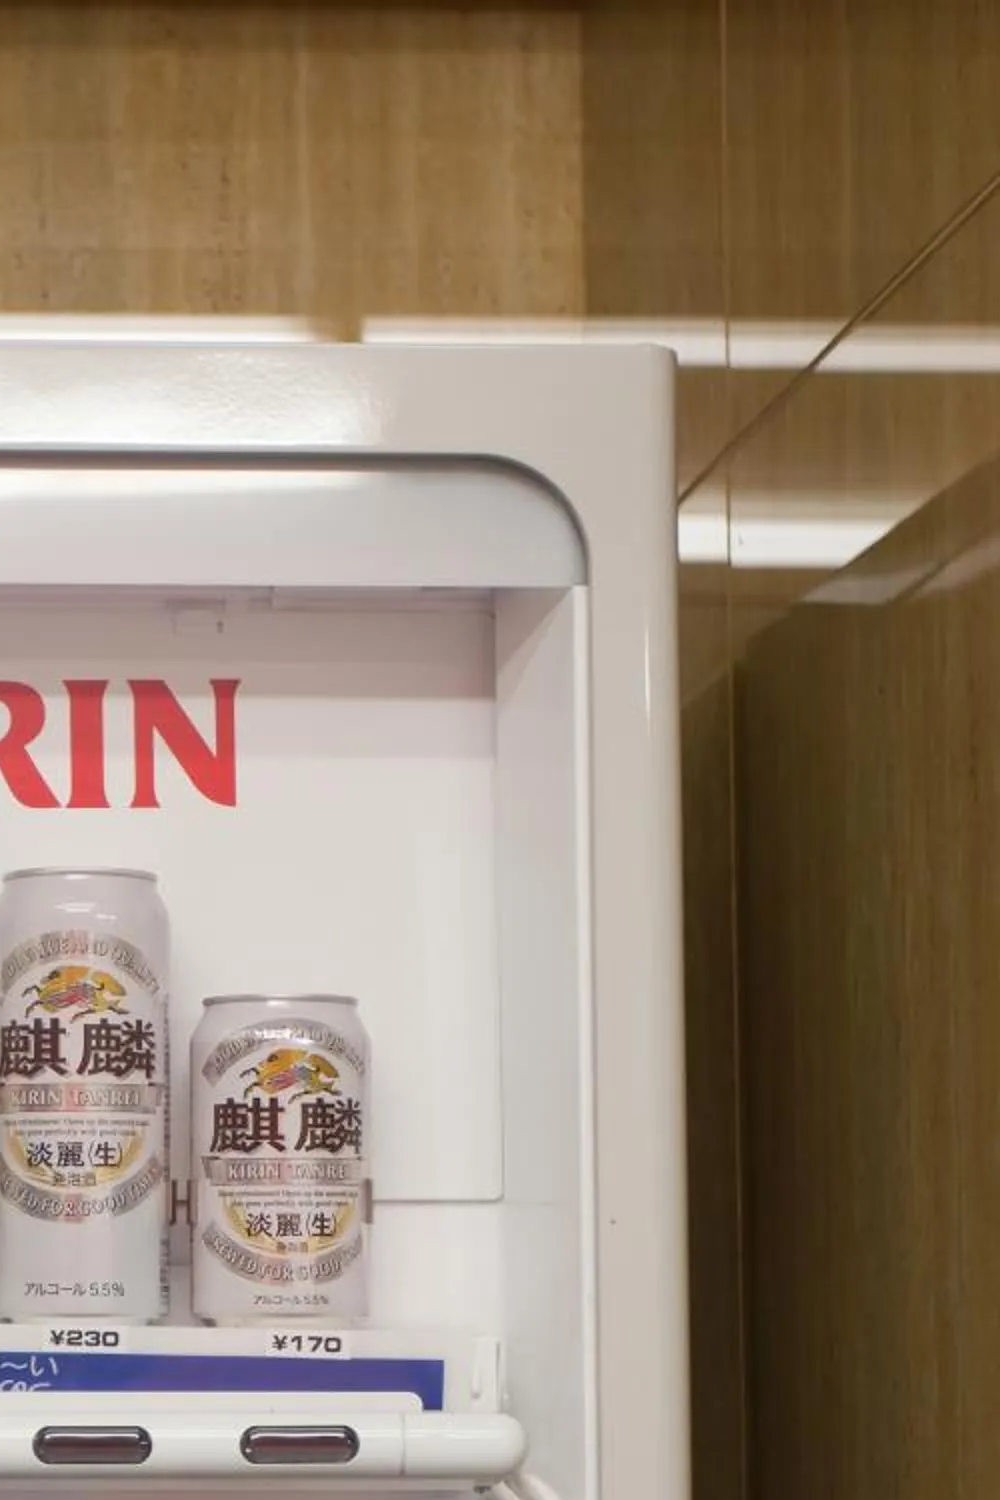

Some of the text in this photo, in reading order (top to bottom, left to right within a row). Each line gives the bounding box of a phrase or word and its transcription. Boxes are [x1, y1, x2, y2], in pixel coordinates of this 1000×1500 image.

[210, 1098, 363, 1154] 麒麟
[50, 1330, 120, 1347] ¥230
[272, 1335, 343, 1353] ¥170
